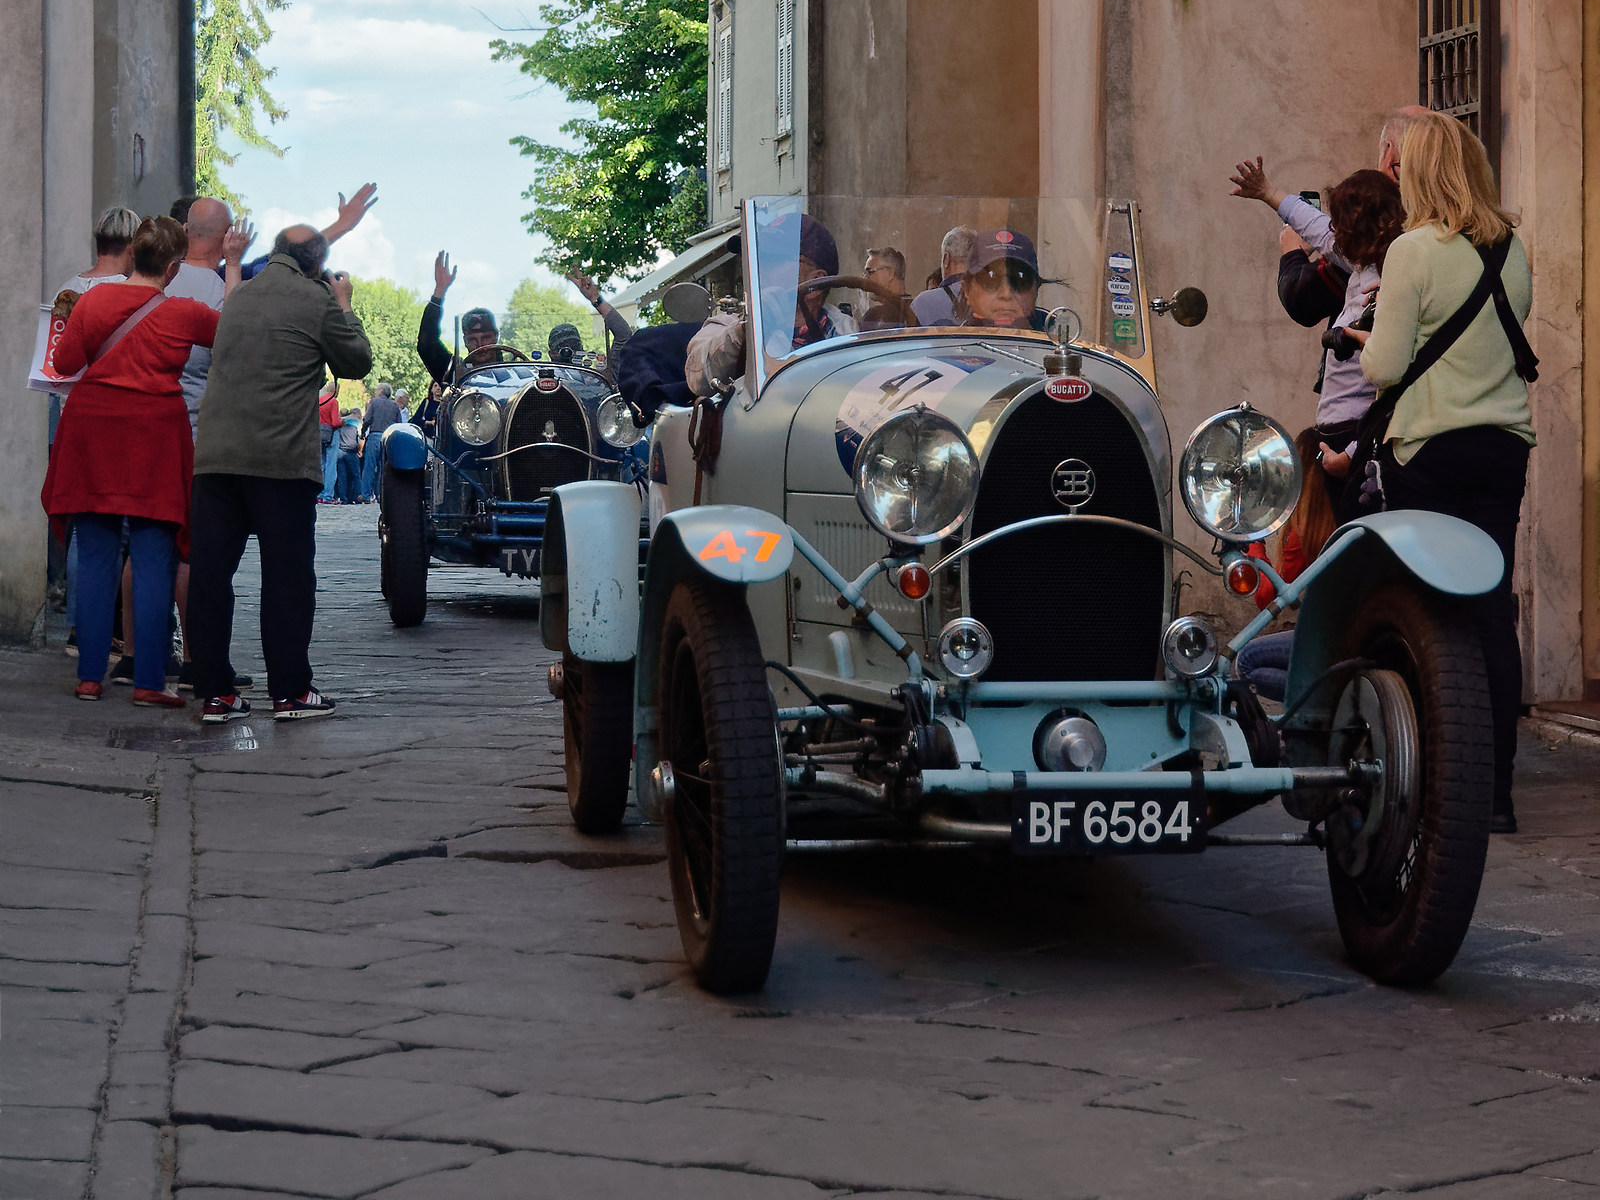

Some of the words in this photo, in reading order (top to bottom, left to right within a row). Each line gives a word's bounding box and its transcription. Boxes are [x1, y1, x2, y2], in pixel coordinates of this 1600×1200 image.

[878, 366, 944, 412] 47
[1051, 384, 1087, 395] BUGATTI
[502, 548, 543, 572] TY
[699, 530, 782, 563] 47
[1029, 801, 1076, 843] BF
[1083, 800, 1192, 844] 6584
